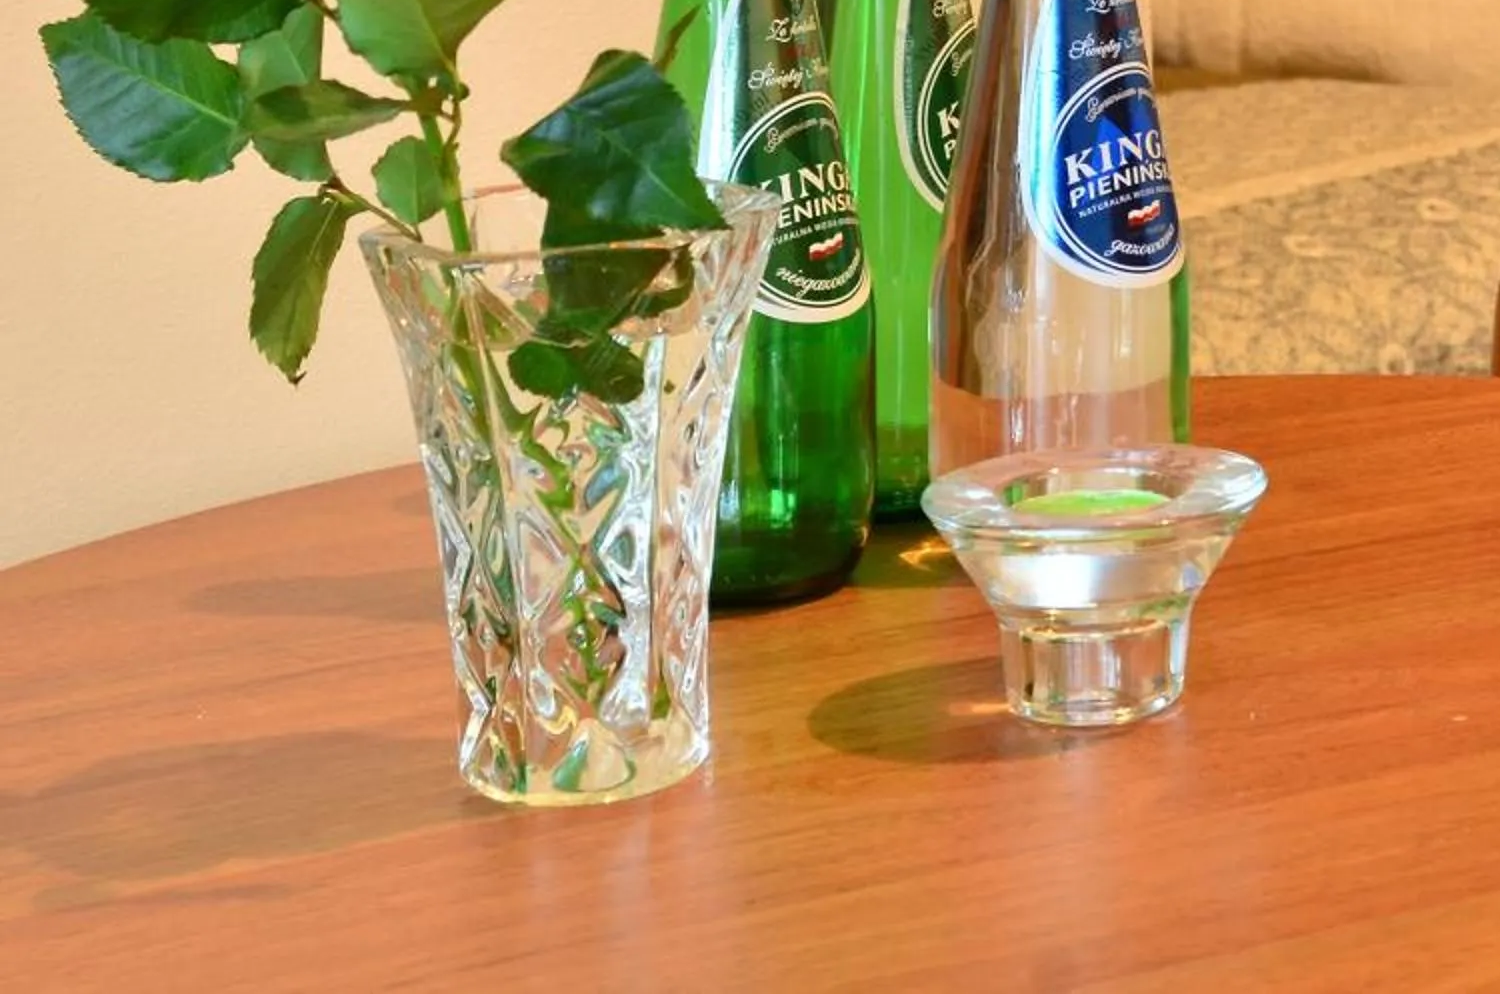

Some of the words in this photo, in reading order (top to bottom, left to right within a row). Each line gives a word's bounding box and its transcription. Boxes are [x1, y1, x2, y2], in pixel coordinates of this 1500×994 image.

[756, 160, 850, 204] ING
[1064, 128, 1166, 185] KING
[1069, 158, 1170, 209] PIENIŃS
